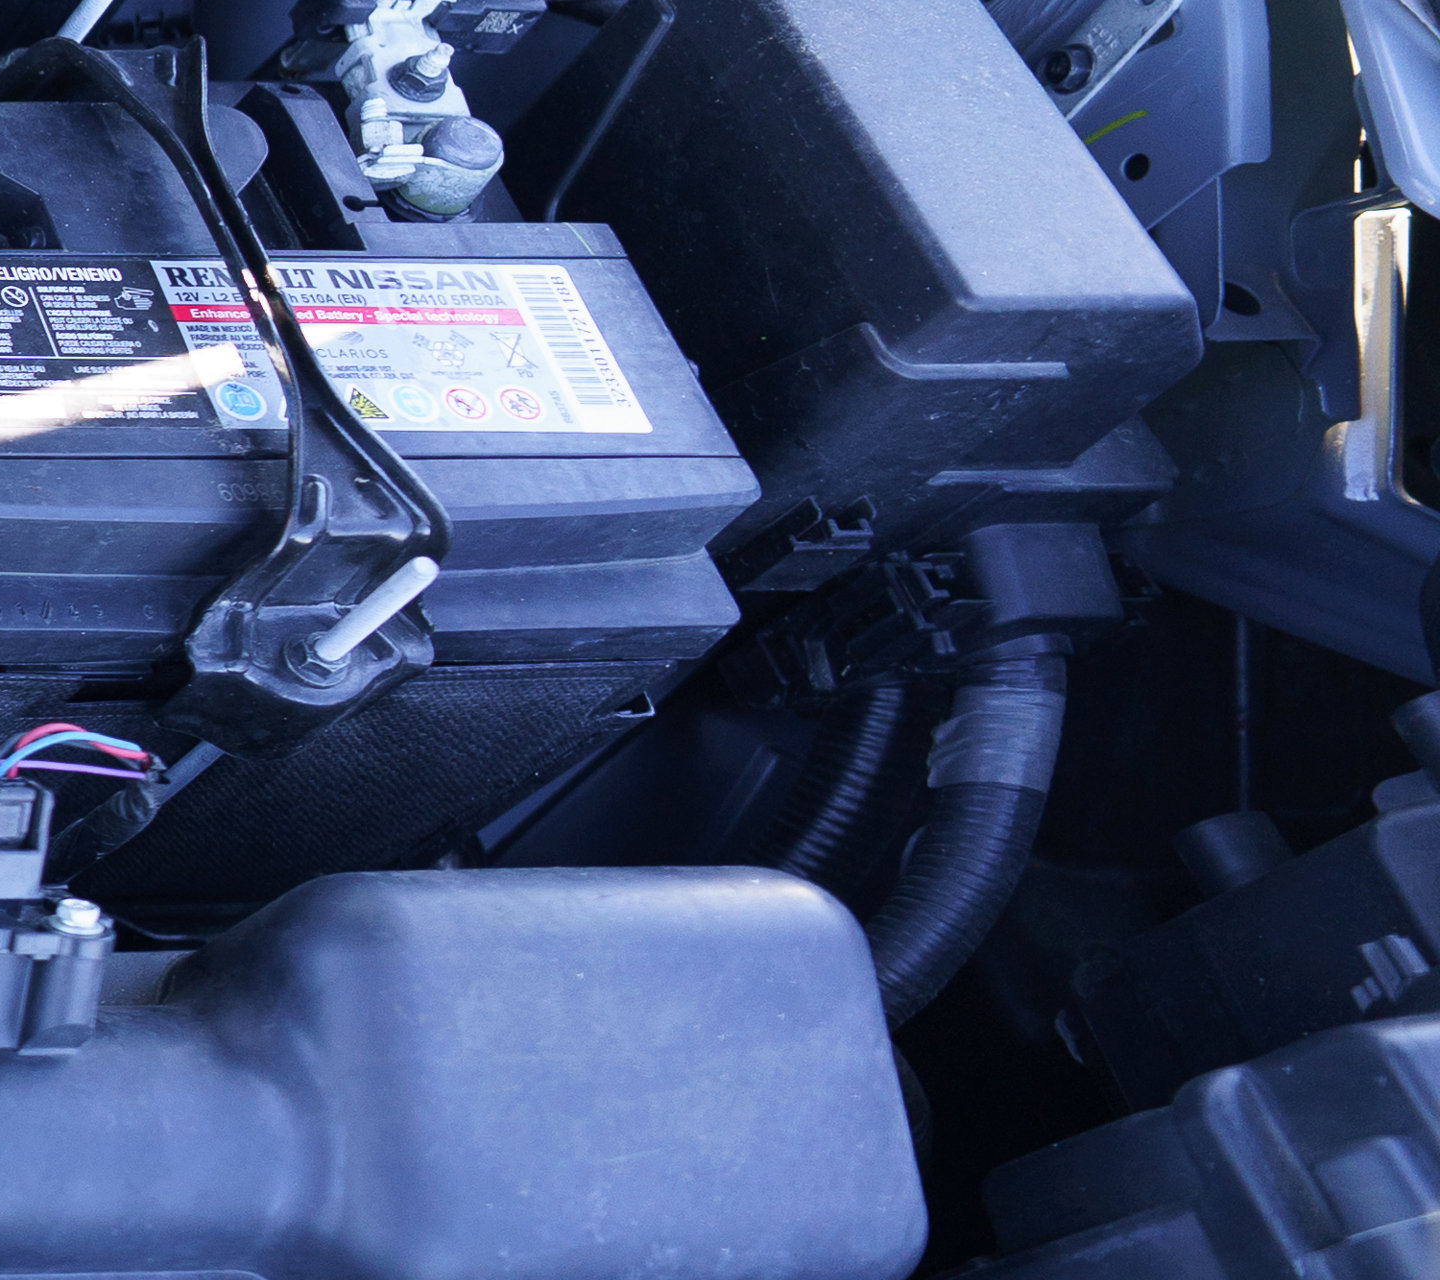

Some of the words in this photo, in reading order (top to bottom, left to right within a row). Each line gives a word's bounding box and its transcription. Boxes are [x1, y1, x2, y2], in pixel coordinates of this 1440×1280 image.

[327, 268, 502, 291] NISSAN
[175, 291, 199, 302] 12V
[302, 293, 334, 304] 510A
[337, 293, 367, 306] (EN)
[400, 293, 446, 306] 24410
[316, 309, 364, 322] Battery
[375, 310, 423, 323] Special
[424, 310, 500, 324] technology
[316, 348, 389, 360] CLARIOS
